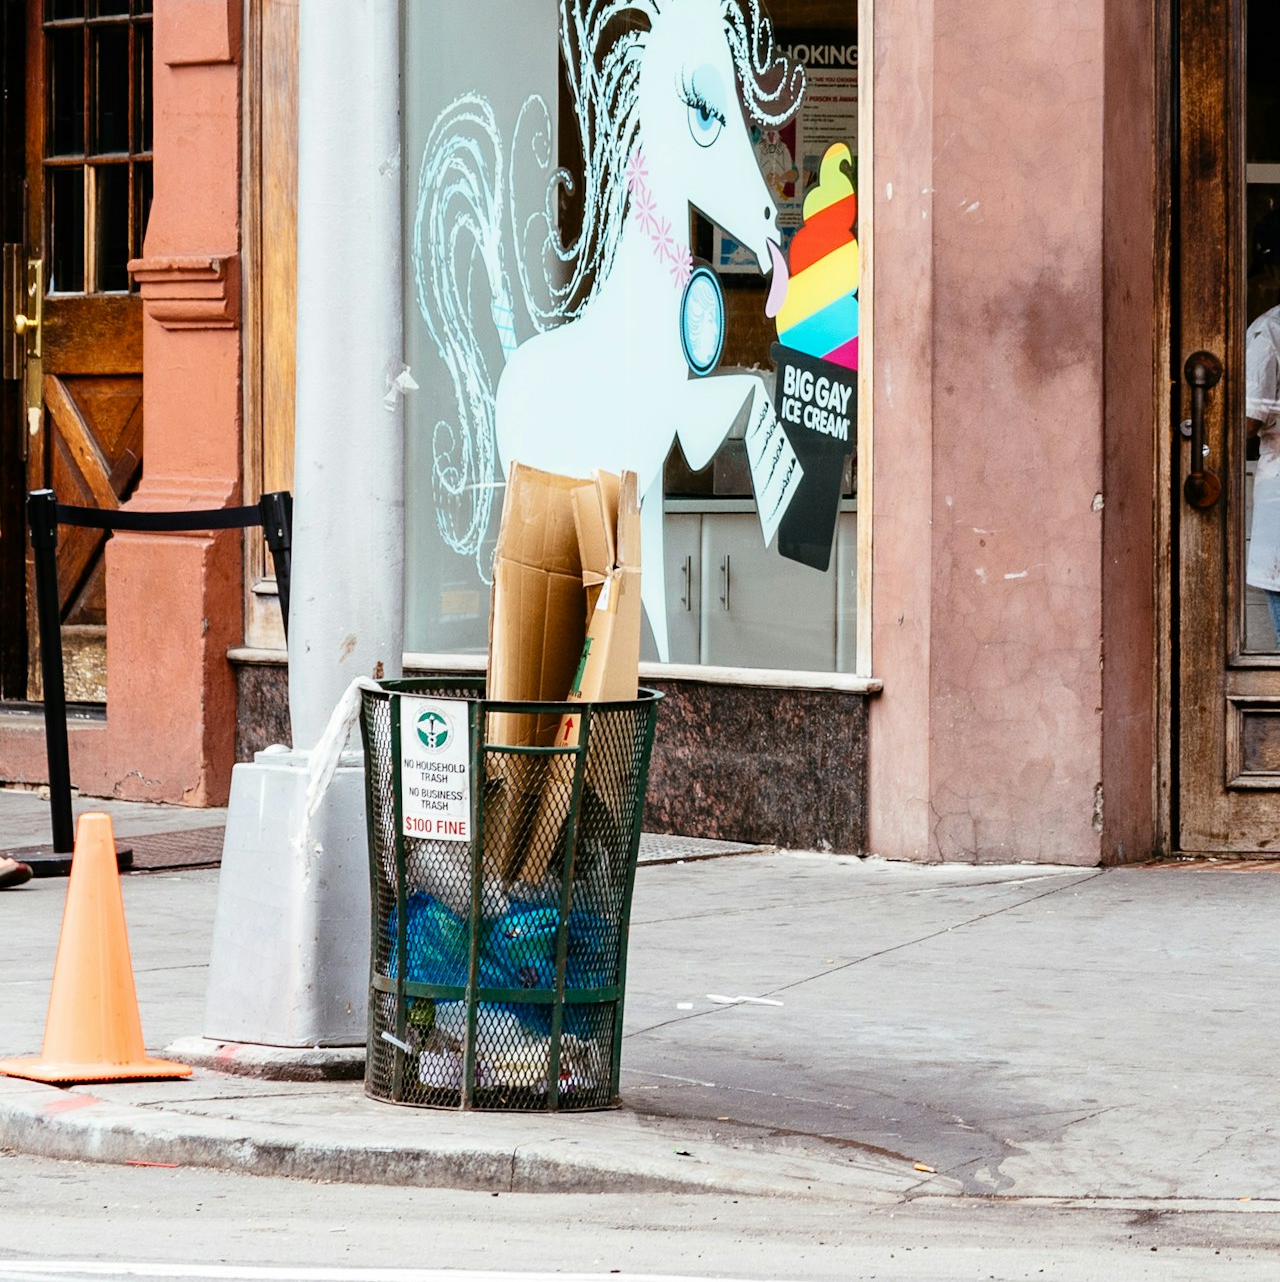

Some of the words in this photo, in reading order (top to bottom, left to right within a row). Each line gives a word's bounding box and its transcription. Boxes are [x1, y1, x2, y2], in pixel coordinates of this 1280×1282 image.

[783, 364, 814, 402] BIG
[815, 376, 853, 415] GAY
[781, 396, 802, 425] ICE
[404, 759, 414, 769] NO
[415, 760, 466, 774] HOUSEHOLD
[421, 771, 448, 784] TRASH
[409, 787, 419, 797] NO
[421, 788, 463, 801] BUSINESS
[421, 799, 449, 811] TRASH
[405, 815, 432, 833] $100
[436, 819, 466, 836] FINE
